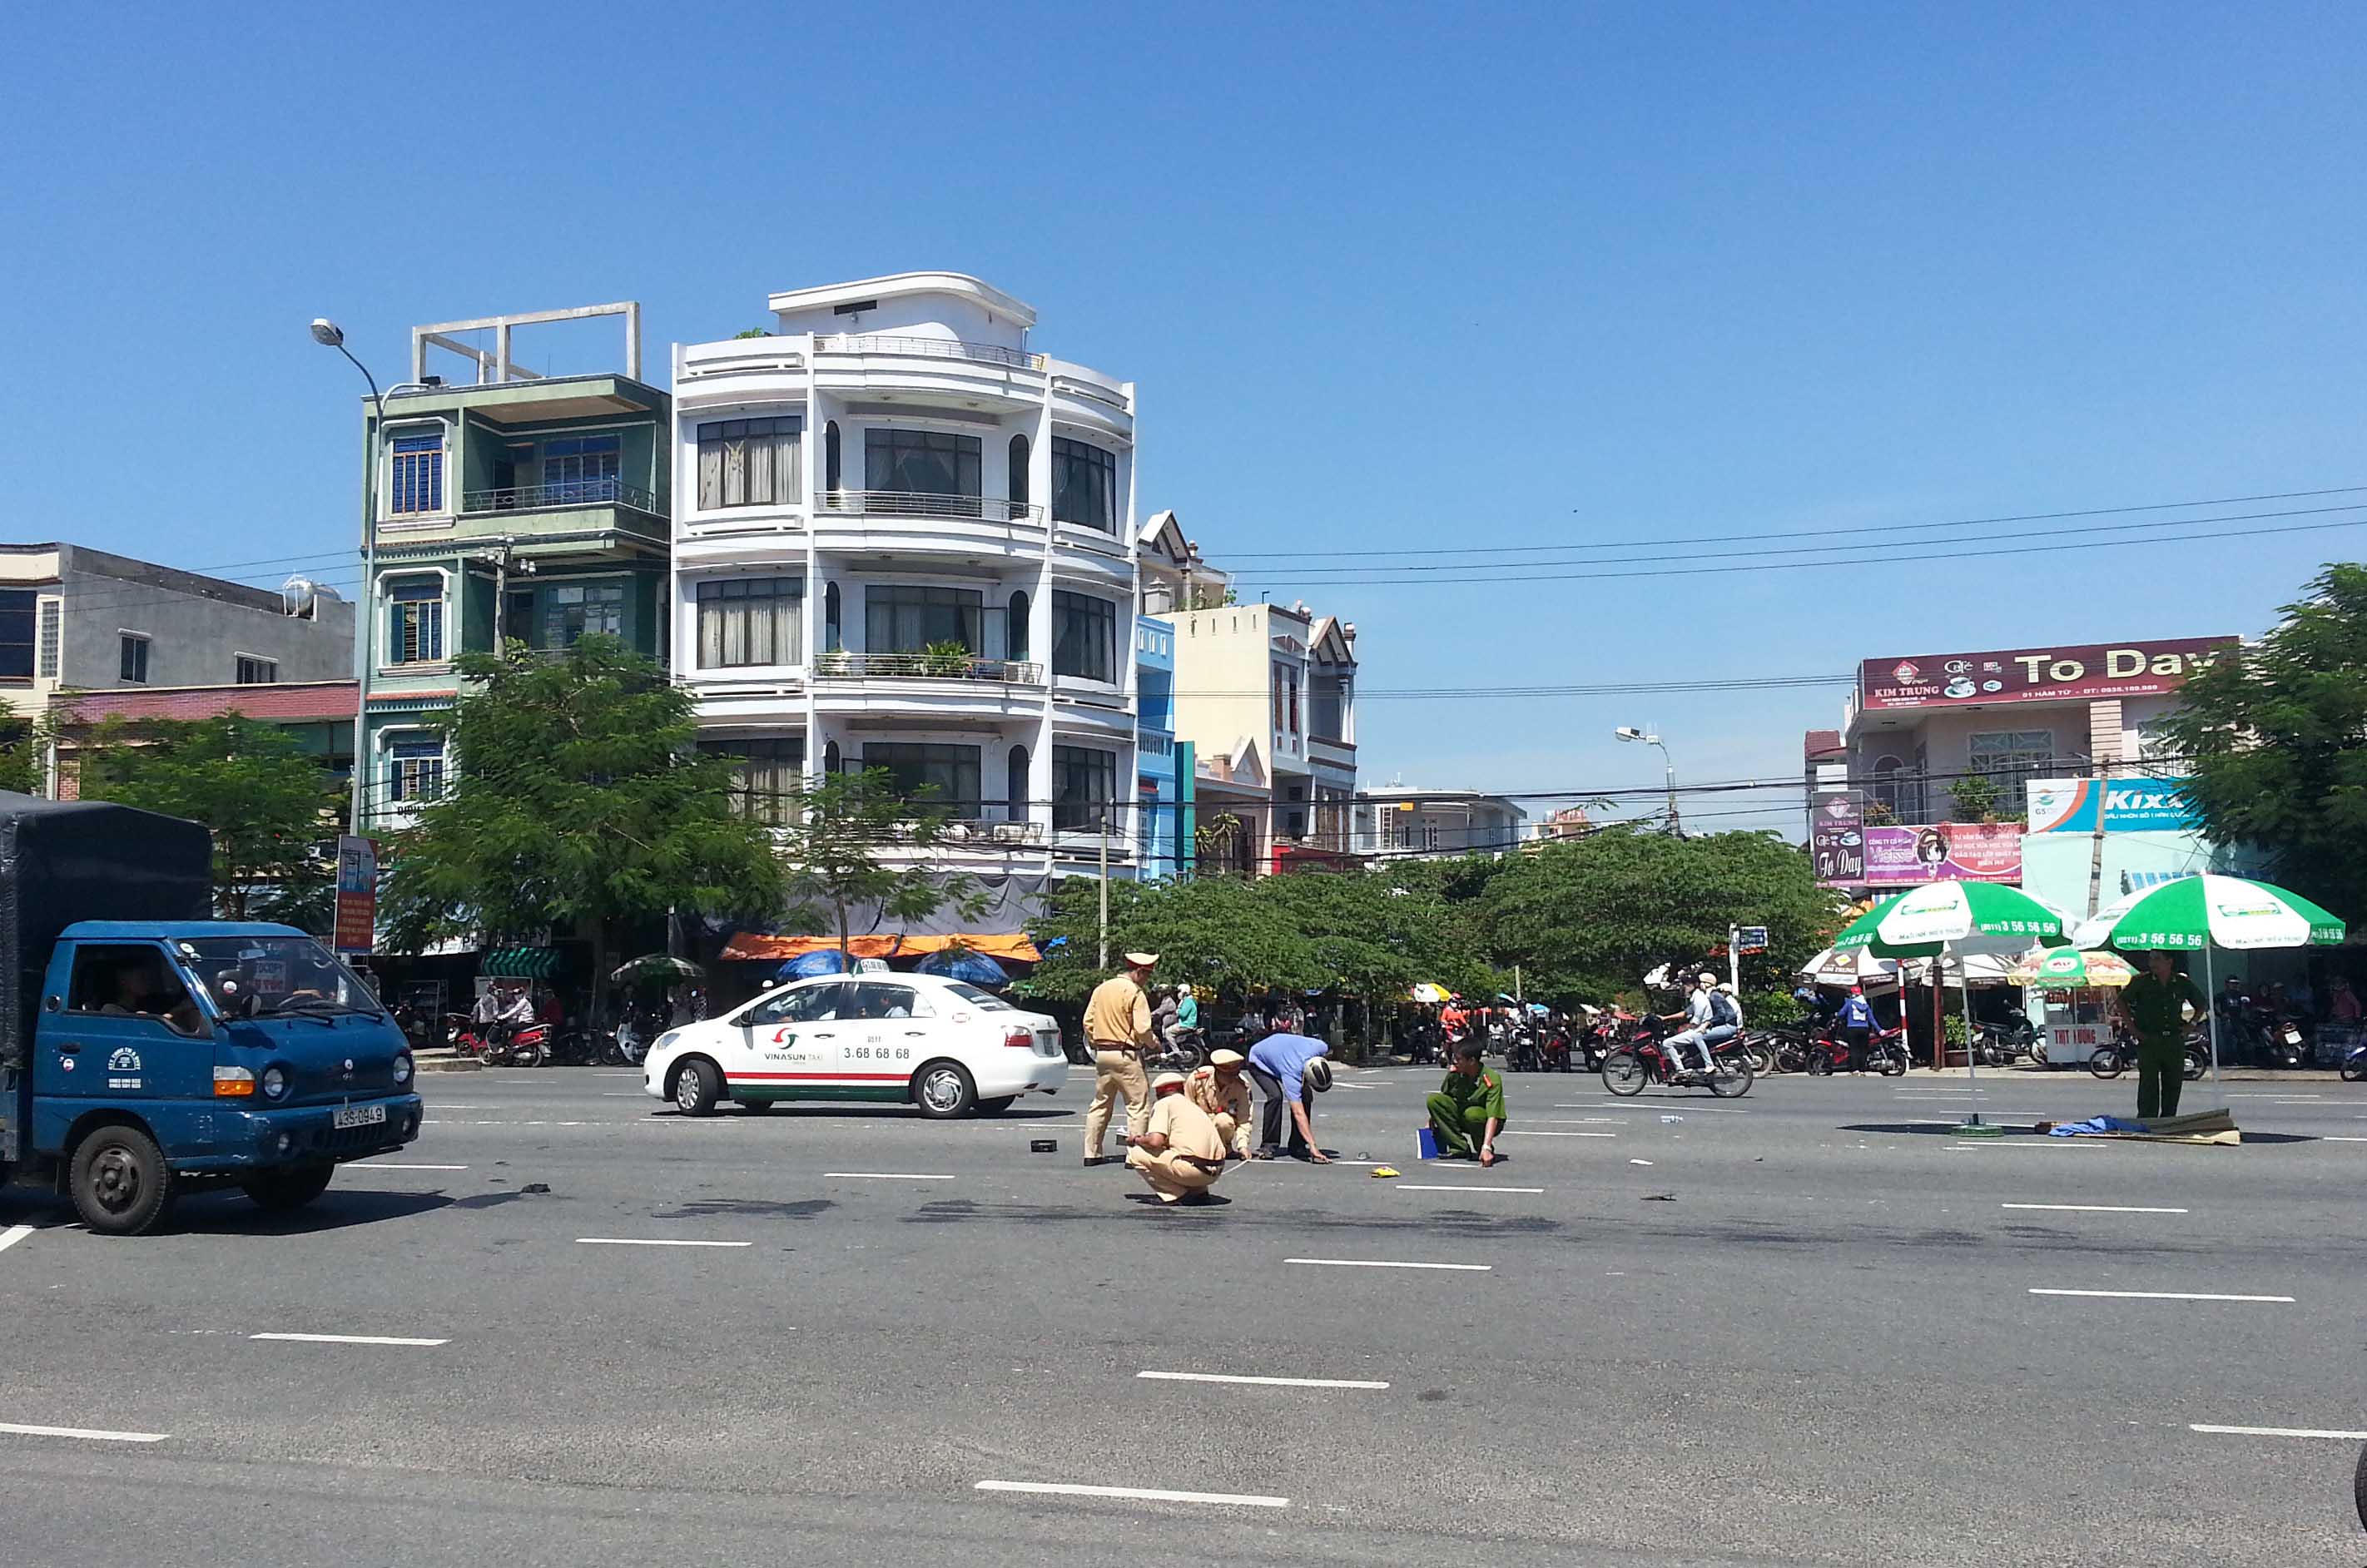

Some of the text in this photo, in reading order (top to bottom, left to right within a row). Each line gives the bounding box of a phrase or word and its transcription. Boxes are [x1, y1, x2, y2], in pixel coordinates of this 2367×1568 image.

[2014, 648, 2220, 683] To Day
[1874, 686, 1939, 697] KIM TRUNG
[1819, 849, 1862, 877] To Day
[2001, 920, 2009, 931] 3
[2011, 920, 2024, 932] 56
[2027, 921, 2040, 933] 56
[2042, 922, 2057, 933] 56
[2139, 933, 2147, 944] 3
[2151, 933, 2166, 944] 56
[2169, 933, 2184, 945] 56
[2187, 934, 2202, 945] 56
[765, 1053, 806, 1061] VINASUN
[844, 1048, 910, 1059] 3.68 68 68
